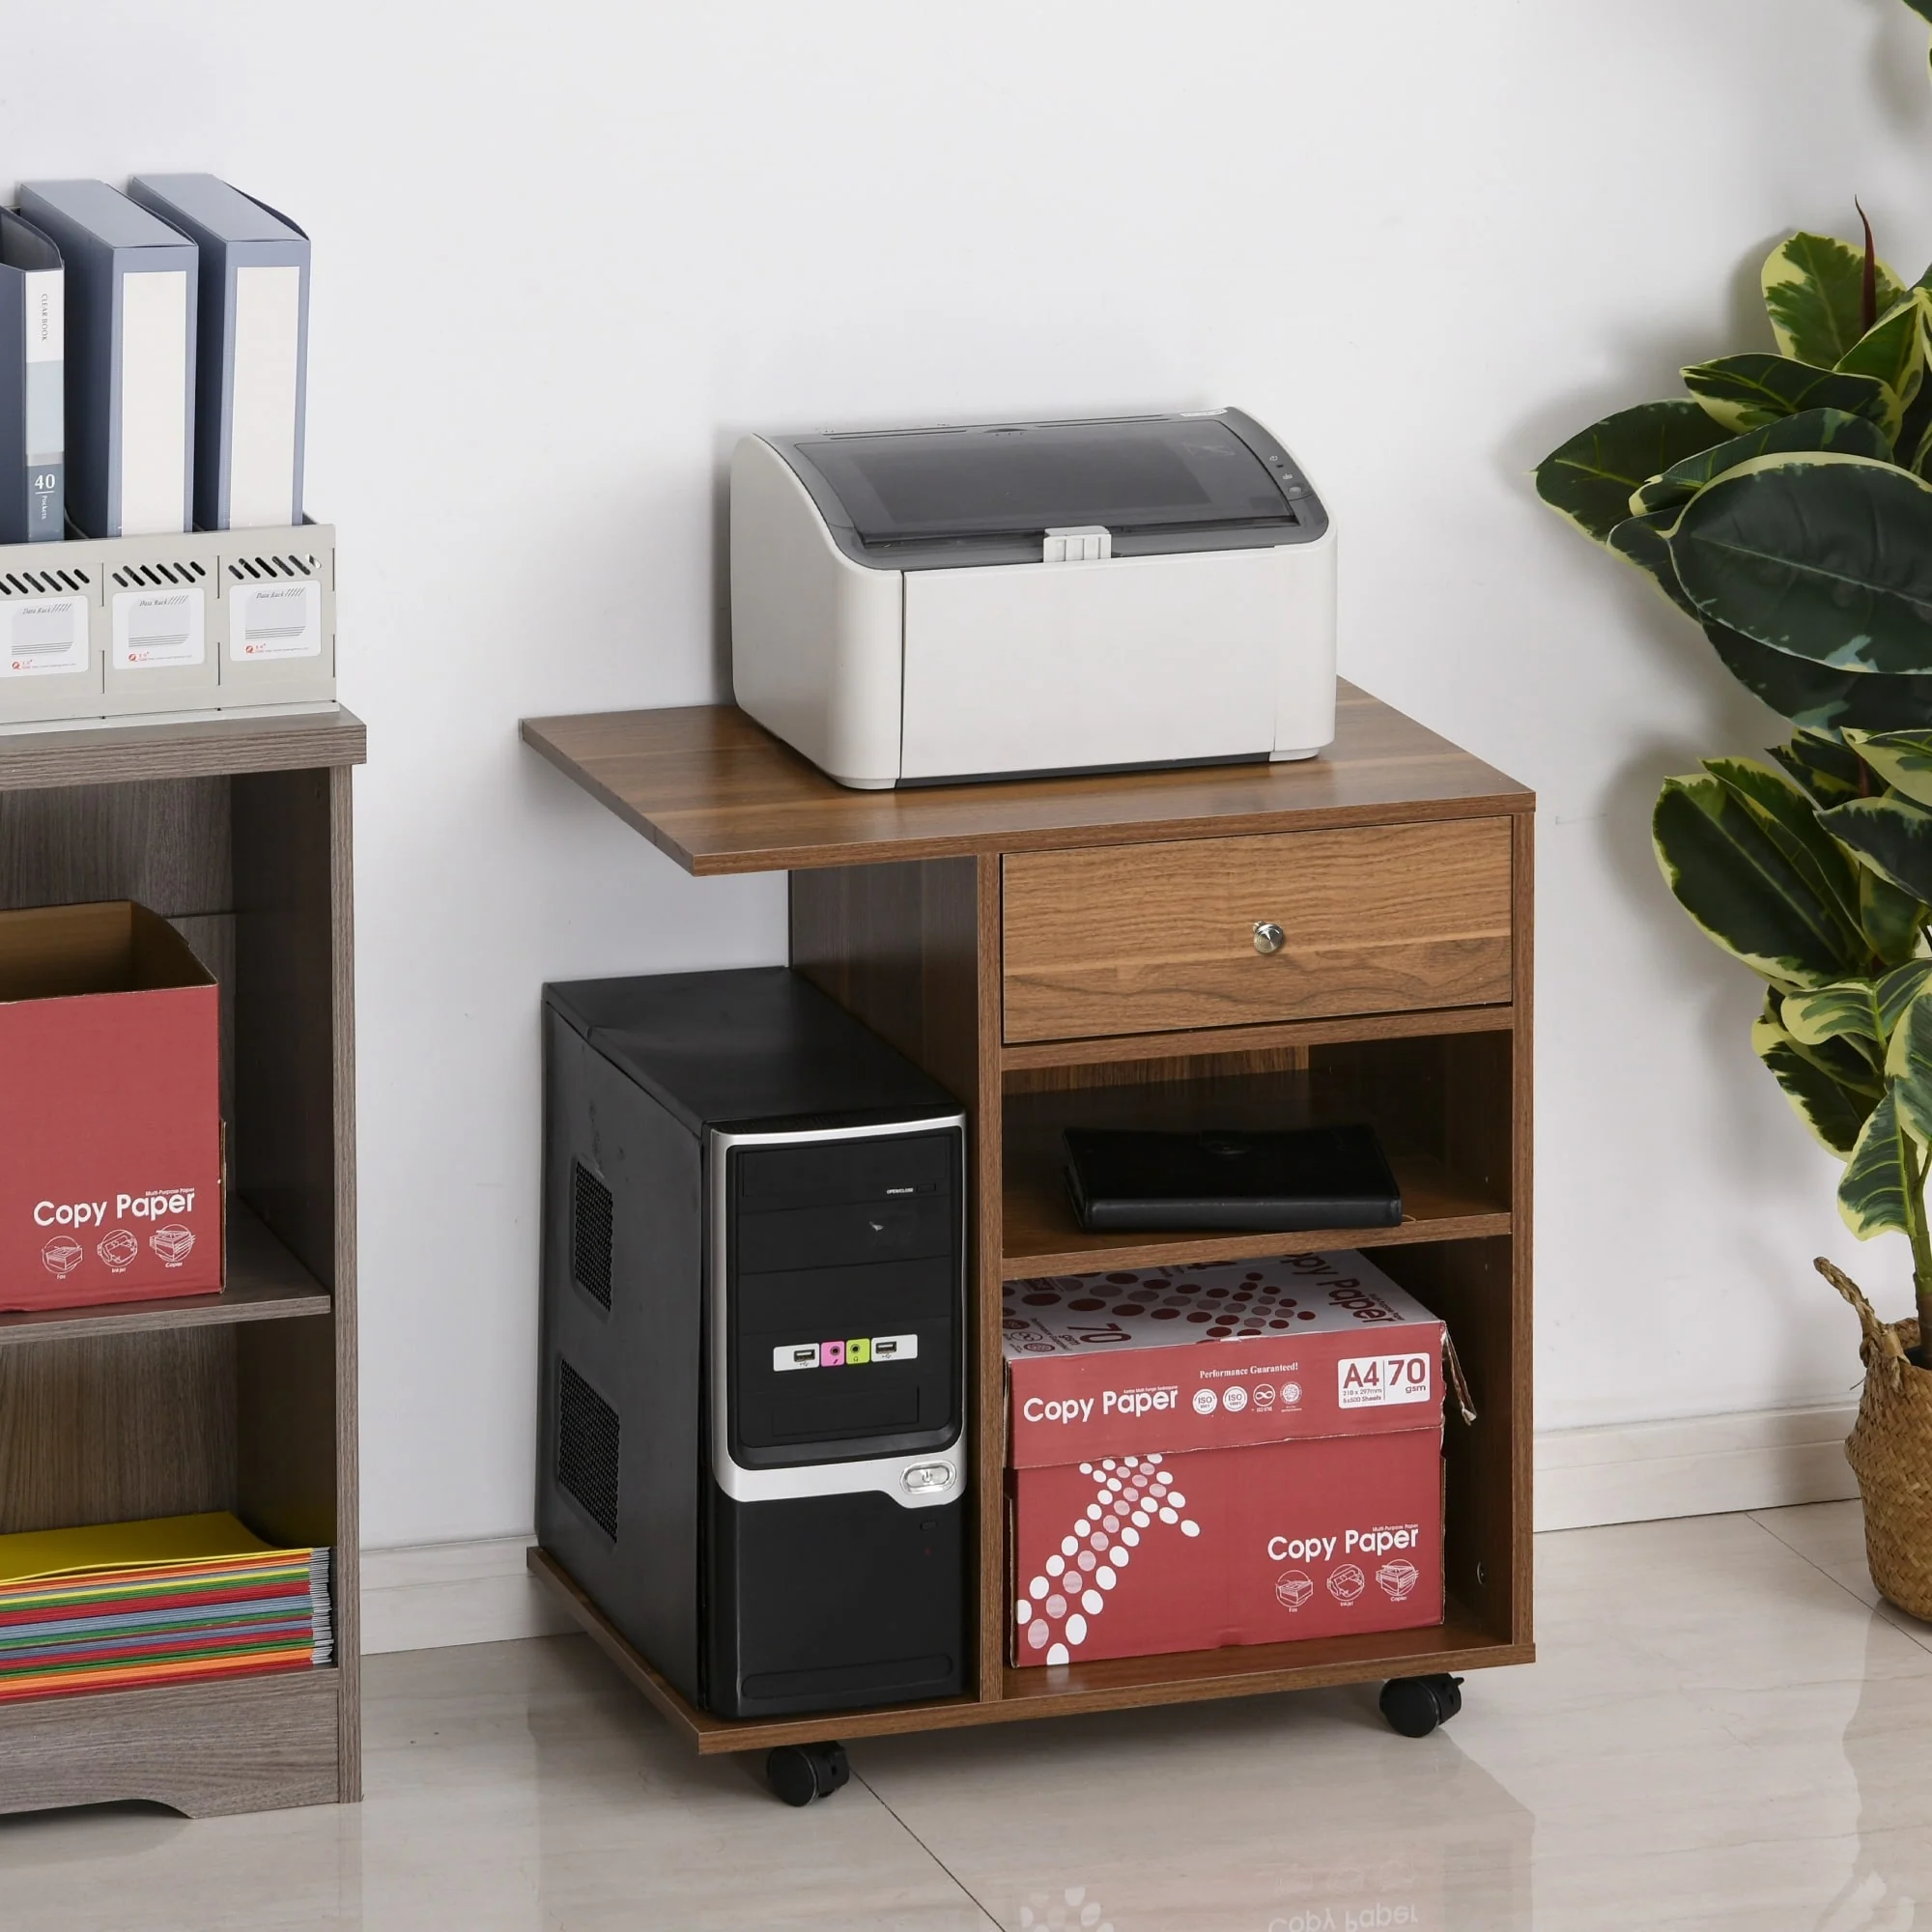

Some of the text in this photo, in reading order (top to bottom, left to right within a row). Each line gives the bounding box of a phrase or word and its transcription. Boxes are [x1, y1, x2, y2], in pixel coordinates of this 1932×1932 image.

[34, 474, 56, 490] 40
[33, 1193, 195, 1229] Copy Paper
[1316, 1278, 1397, 1322] Paper
[1199, 1362, 1298, 1378] Performance Guaranteed!
[1343, 1361, 1379, 1389] A4
[1388, 1358, 1426, 1384] 70
[1198, 1396, 1212, 1405] ISO
[1228, 1393, 1242, 1402] ISO
[1405, 1384, 1426, 1394] gsm
[1023, 1389, 1179, 1424] Copy Paper
[1267, 1528, 1419, 1563] Copy Paper
